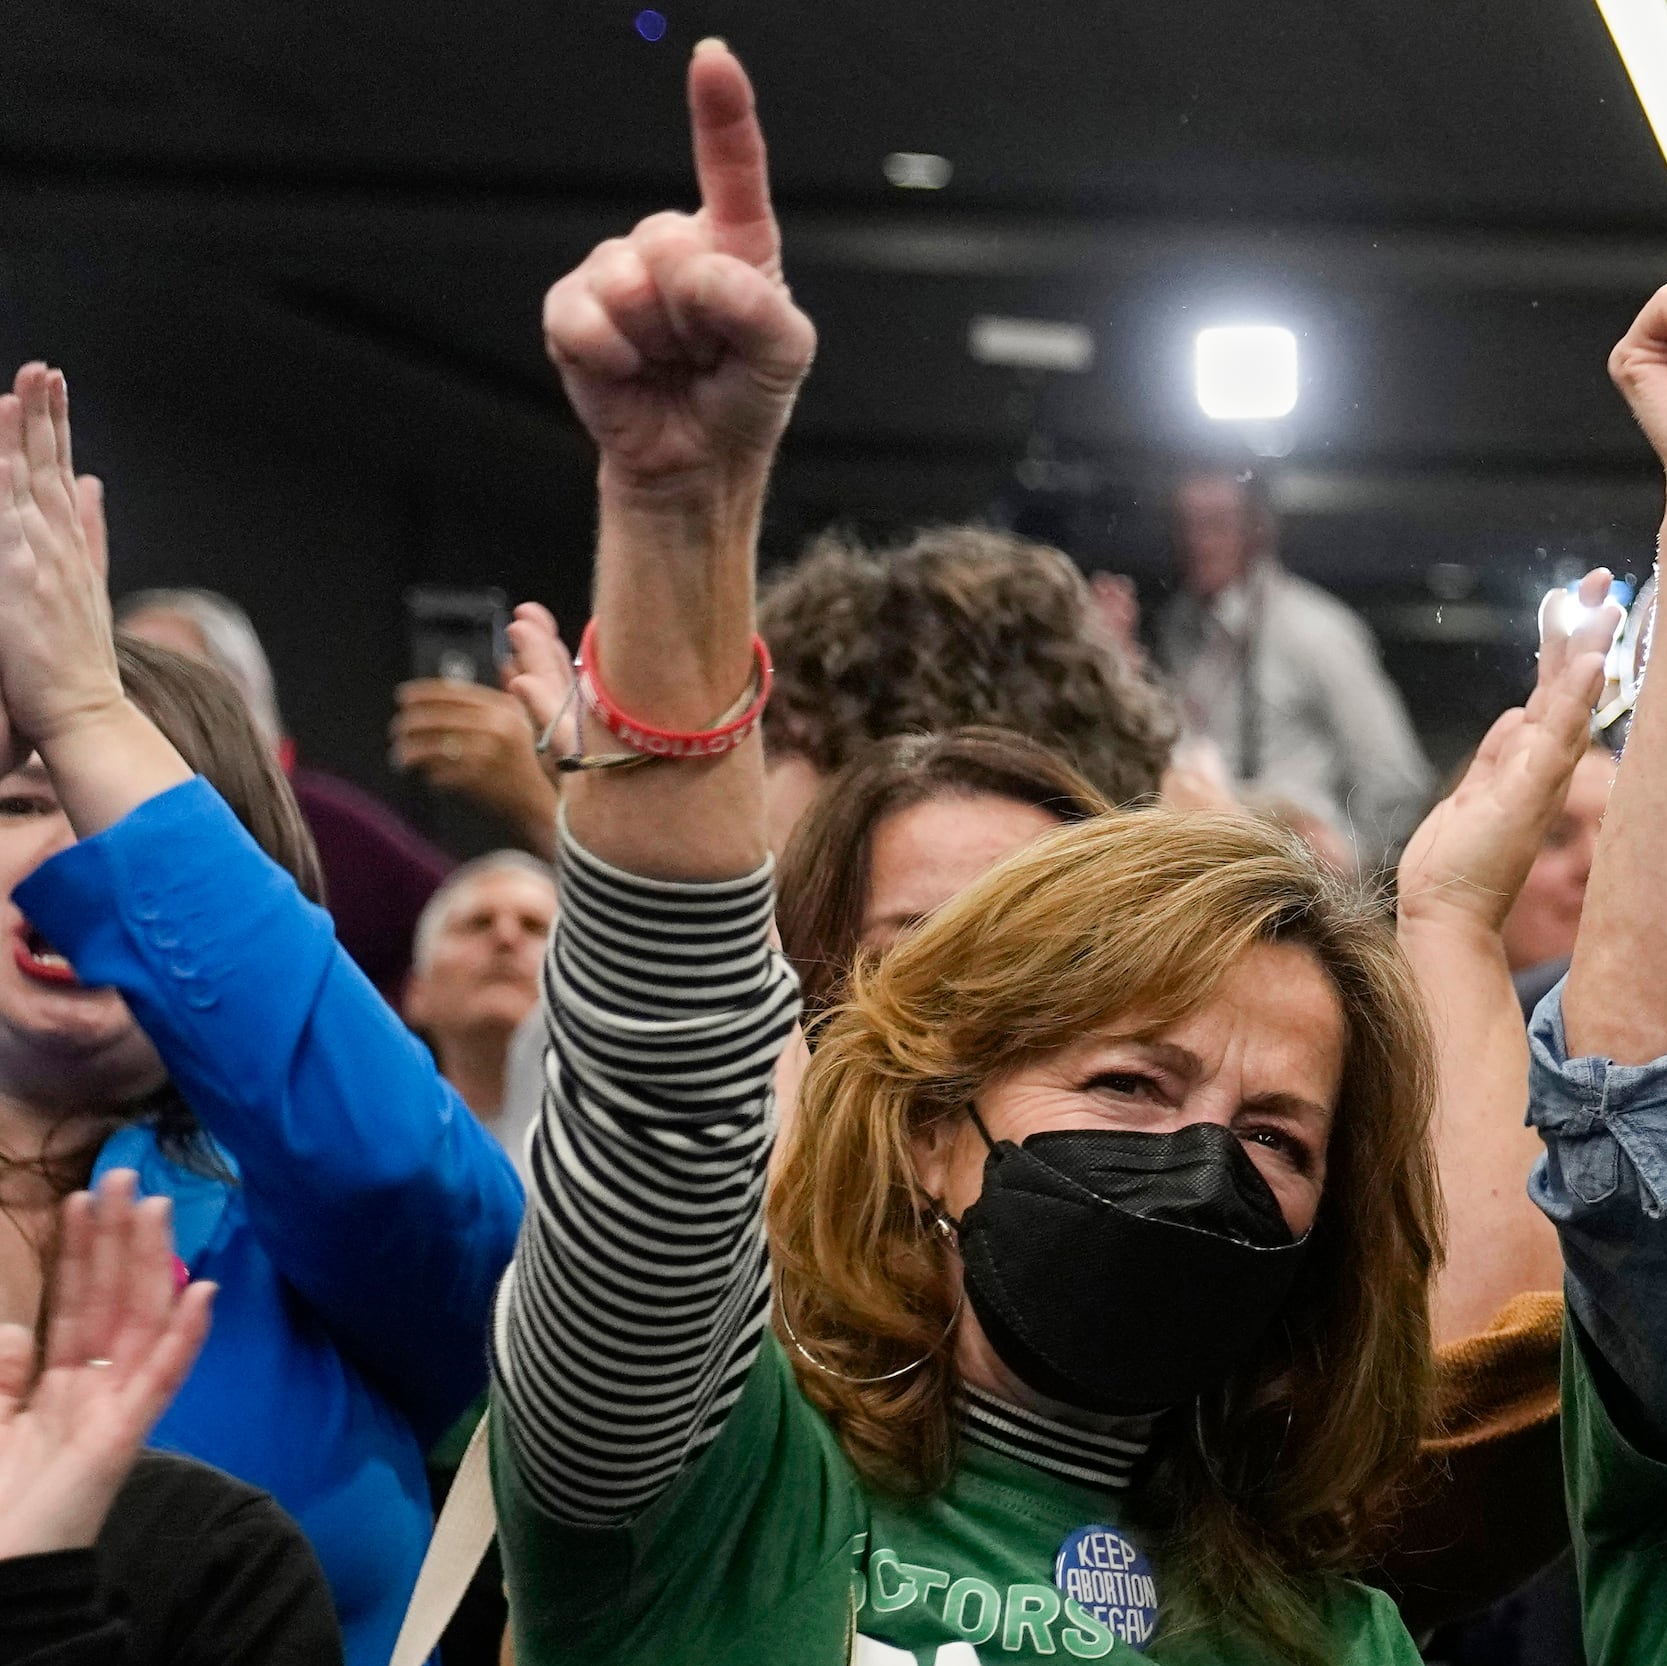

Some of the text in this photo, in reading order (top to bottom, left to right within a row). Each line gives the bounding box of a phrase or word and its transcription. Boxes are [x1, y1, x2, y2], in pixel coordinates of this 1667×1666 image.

[1077, 1532, 1136, 1571] KEEP
[1066, 1568, 1158, 1609] ABORTION
[1088, 1604, 1153, 1645] EGAL
